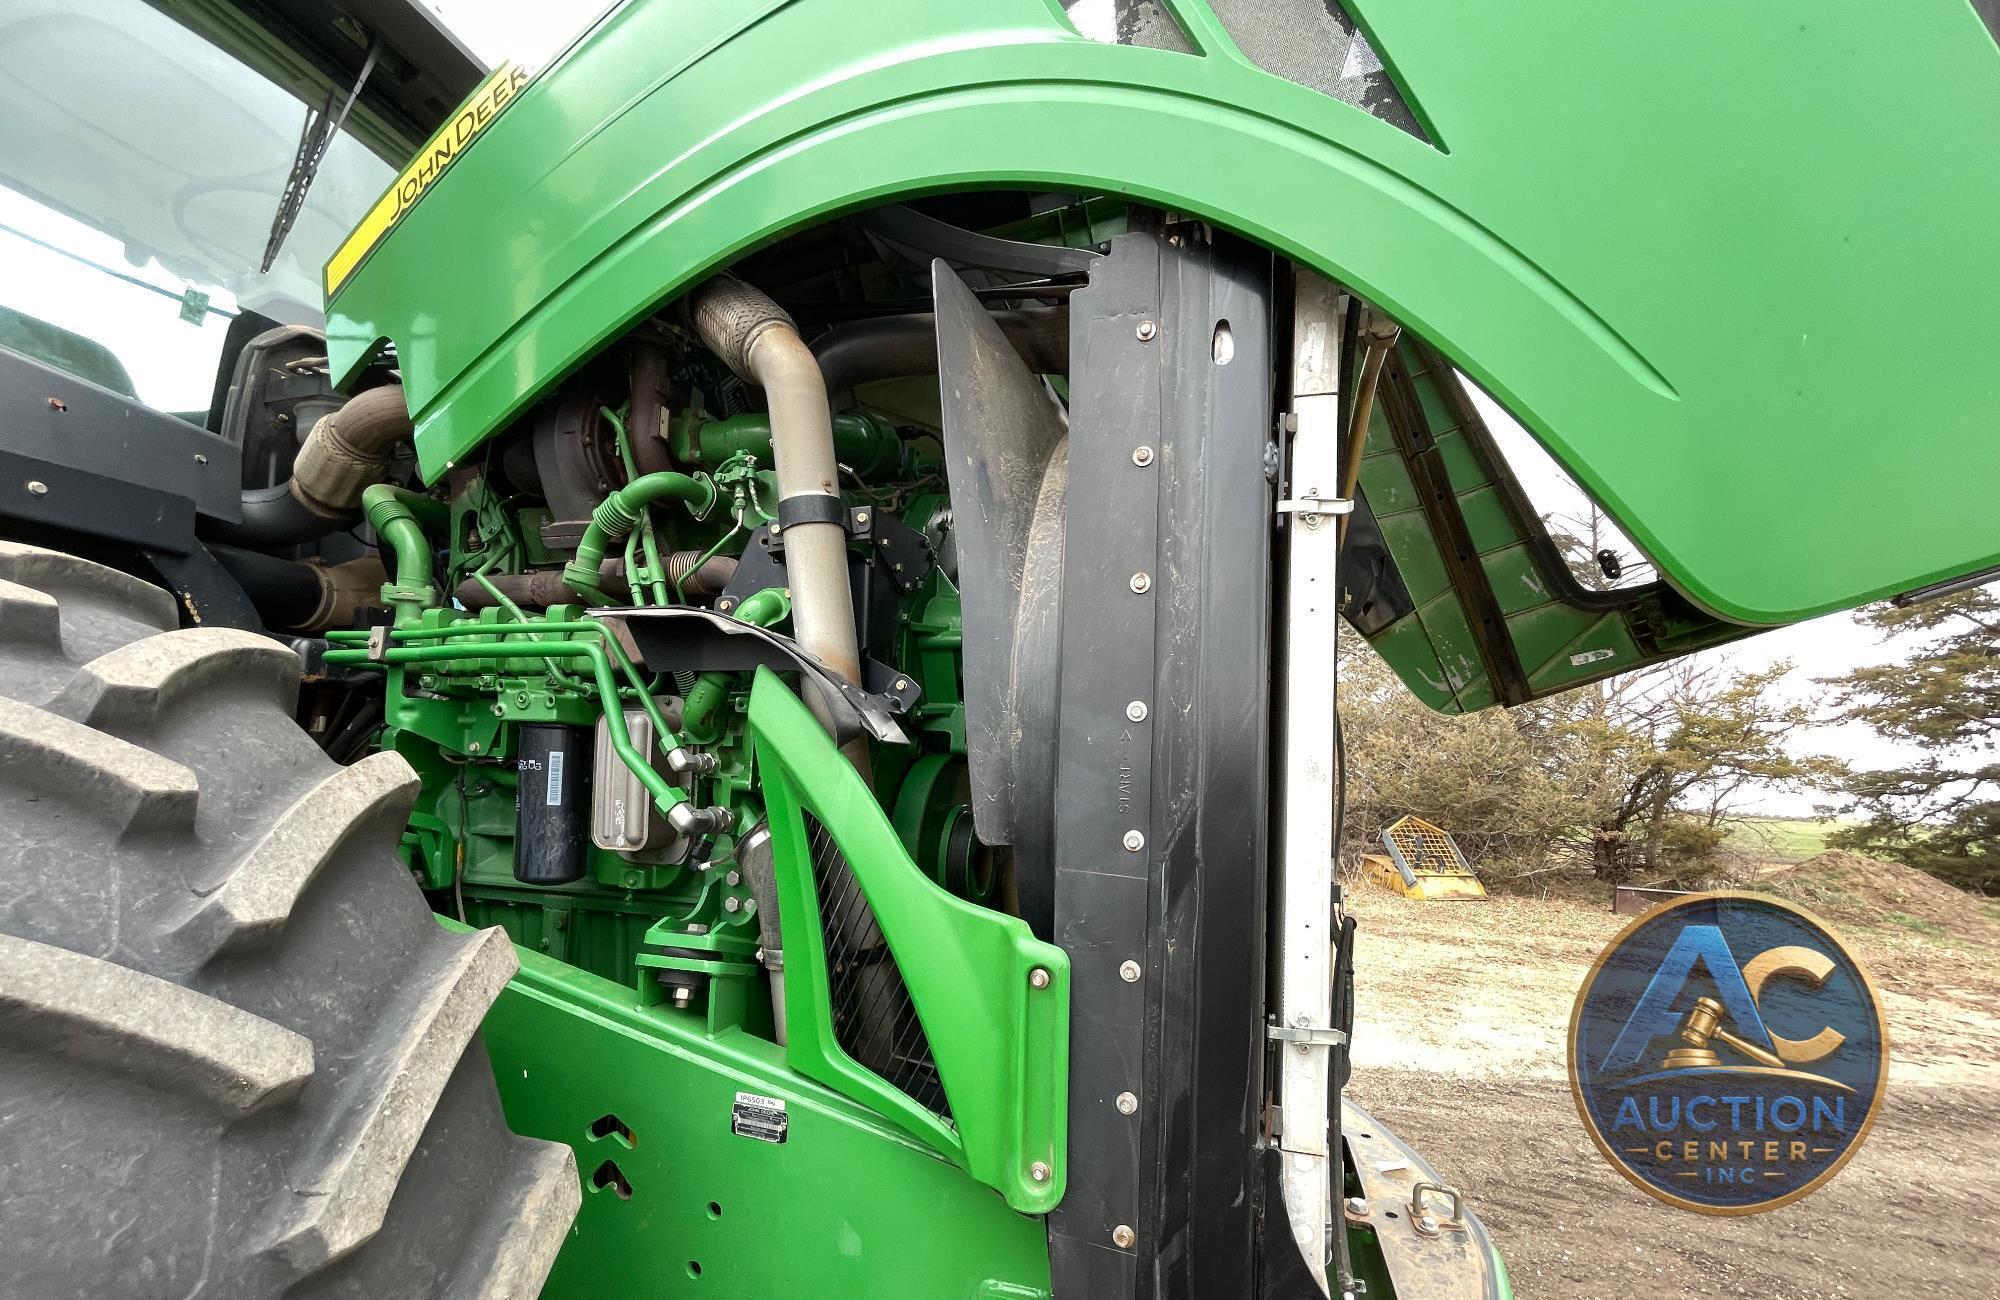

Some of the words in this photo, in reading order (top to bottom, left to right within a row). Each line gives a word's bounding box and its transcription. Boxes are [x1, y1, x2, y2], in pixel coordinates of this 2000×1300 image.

[390, 137, 452, 222] JOHN
[455, 63, 531, 147] DEER
[1118, 763, 1131, 814] START
